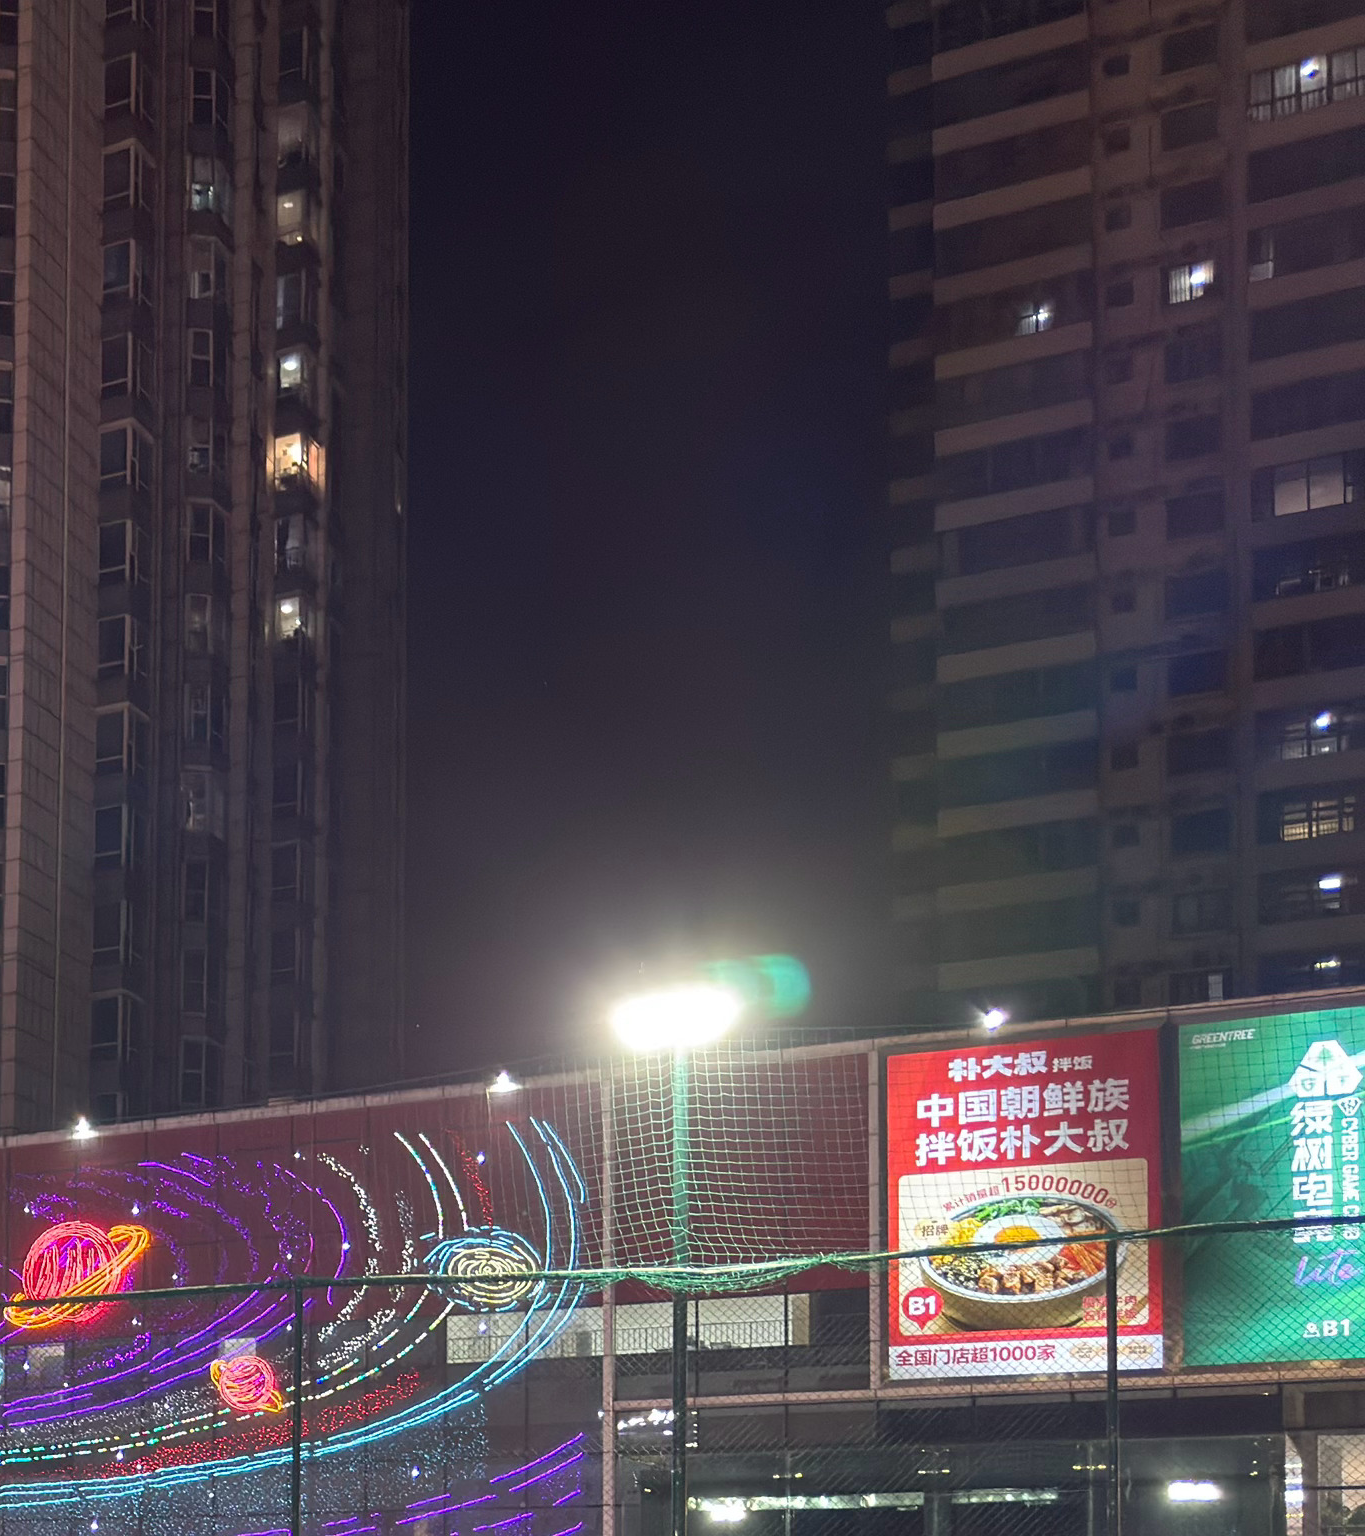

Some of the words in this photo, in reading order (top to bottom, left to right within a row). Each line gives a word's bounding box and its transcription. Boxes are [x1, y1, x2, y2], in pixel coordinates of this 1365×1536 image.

[1192, 1029, 1256, 1045] GREENTREE
[948, 1050, 1048, 1082] 朴大叔
[1052, 1055, 1093, 1073] 拌饭
[915, 1078, 1130, 1128] 中国朝鲜族
[915, 1118, 1130, 1167] 拌饭朴大叔
[1342, 1204, 1361, 1241] CB
[908, 1296, 936, 1316] B1
[1323, 1319, 1350, 1337] B1
[896, 1344, 1056, 1367] 全国门店超1000家
